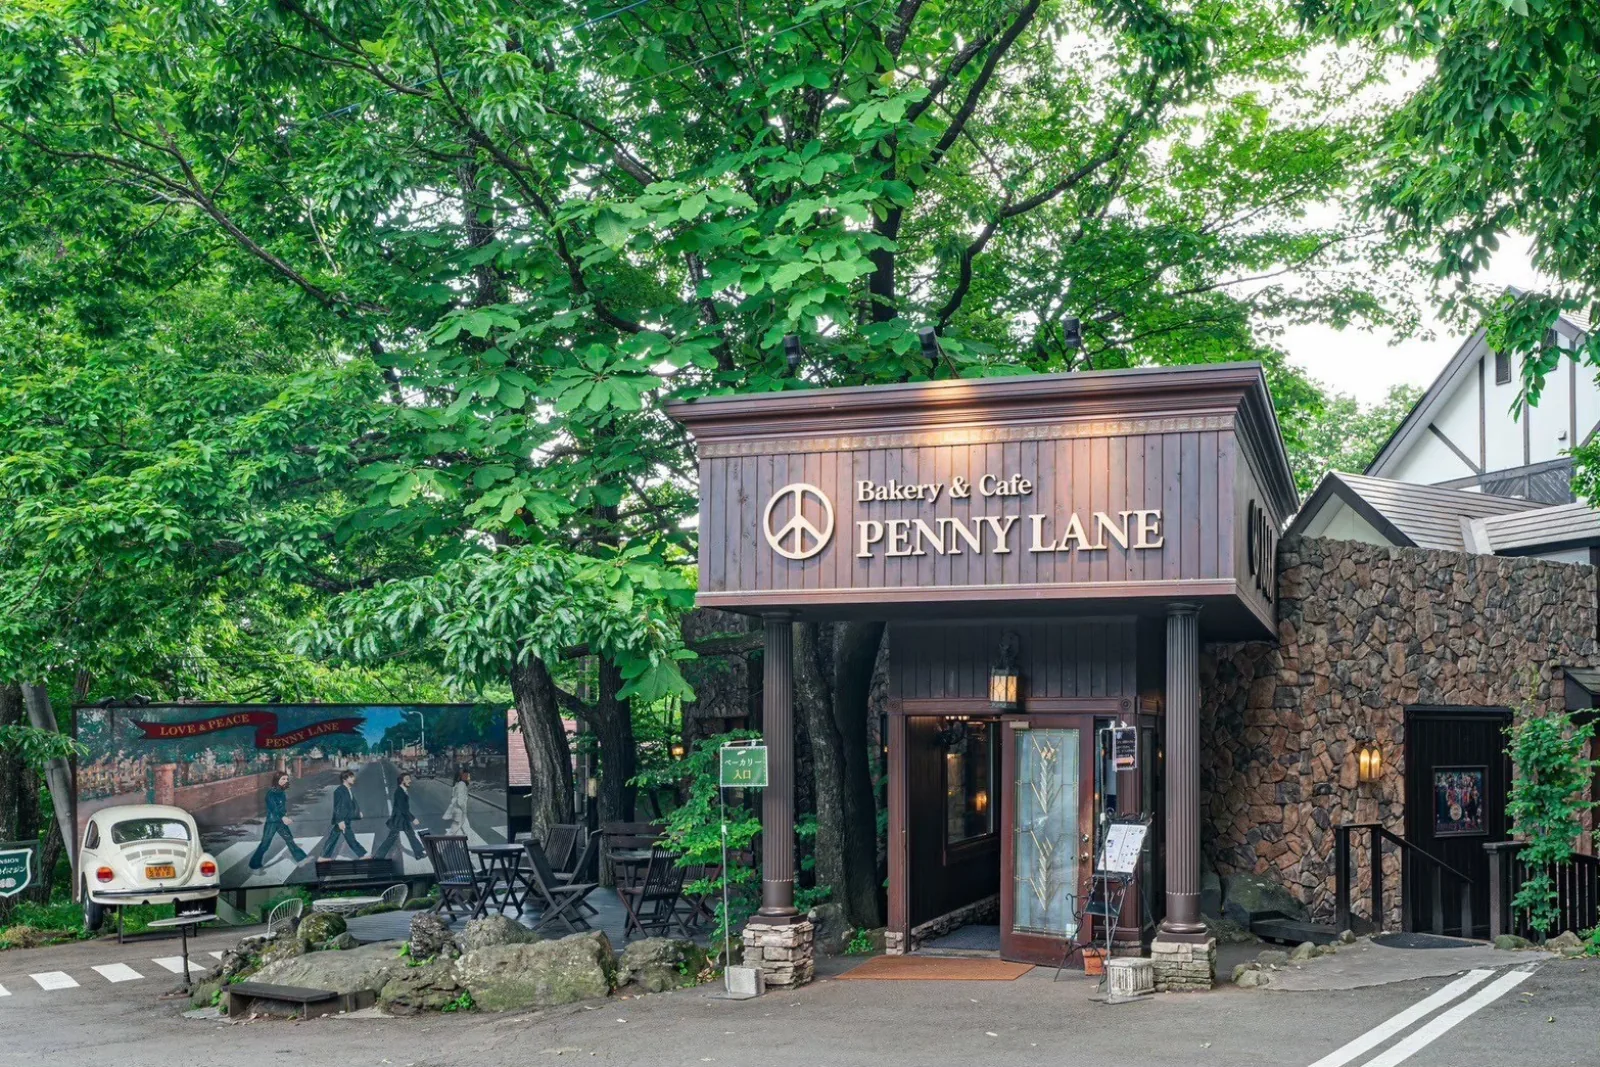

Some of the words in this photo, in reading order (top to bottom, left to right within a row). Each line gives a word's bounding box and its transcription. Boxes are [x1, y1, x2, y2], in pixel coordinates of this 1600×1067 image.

[856, 479, 943, 502] Bakery
[948, 475, 971, 498] &
[978, 473, 1032, 496] Cafe
[856, 514, 1020, 558] PENNY
[1028, 509, 1164, 553] LANE
[160, 724, 195, 736] LOVE
[198, 724, 206, 732] &
[208, 713, 250, 730] PEACE
[265, 731, 305, 747] PENNY
[307, 722, 340, 736] LANE
[724, 757, 762, 767] ベーカリー
[733, 769, 751, 780] 入口
